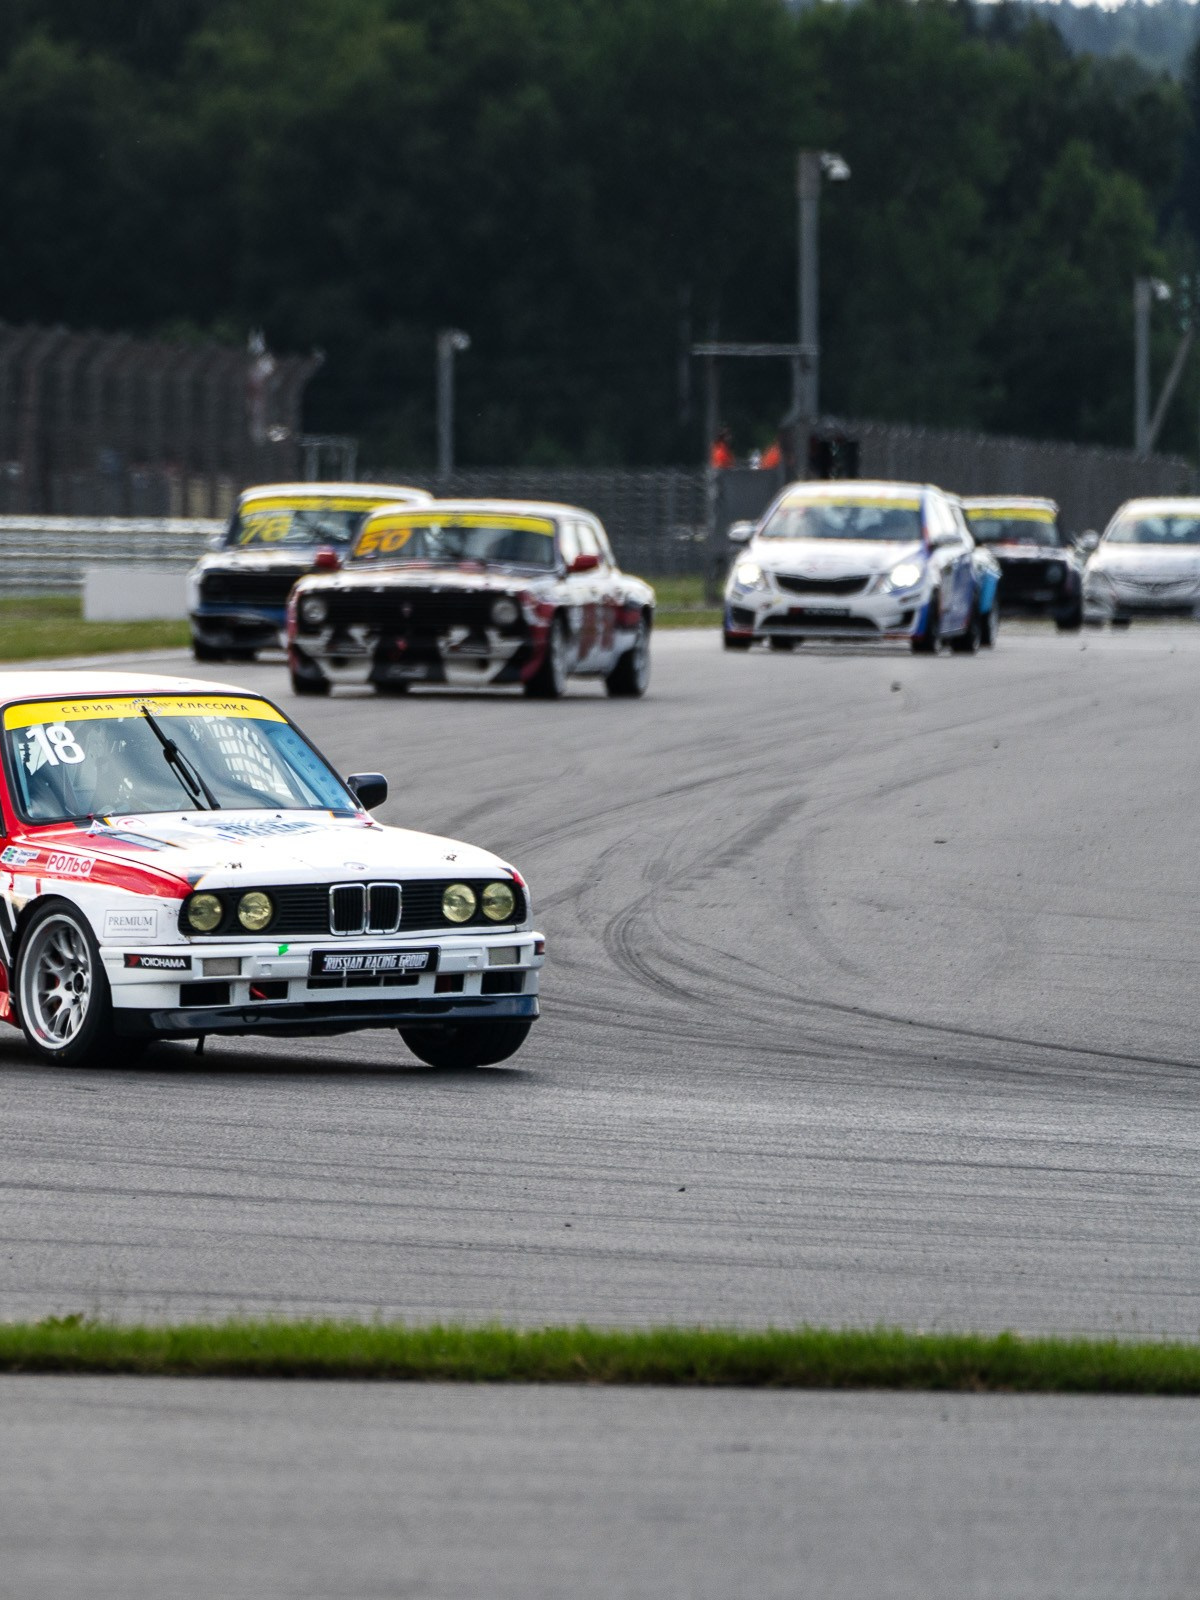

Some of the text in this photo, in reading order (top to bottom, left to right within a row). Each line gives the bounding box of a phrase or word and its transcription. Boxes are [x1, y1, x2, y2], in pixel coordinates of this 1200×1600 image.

[355, 529, 412, 556] 50
[61, 702, 249, 714] СЕРИЯ КЛАССИКА
[25, 725, 86, 766] 18
[47, 854, 92, 873] РОЛЬФ
[108, 916, 153, 926] PREMIUM
[141, 957, 186, 968] YOKOHAMA
[364, 955, 398, 968] RACING
[399, 952, 429, 967] GROUP
